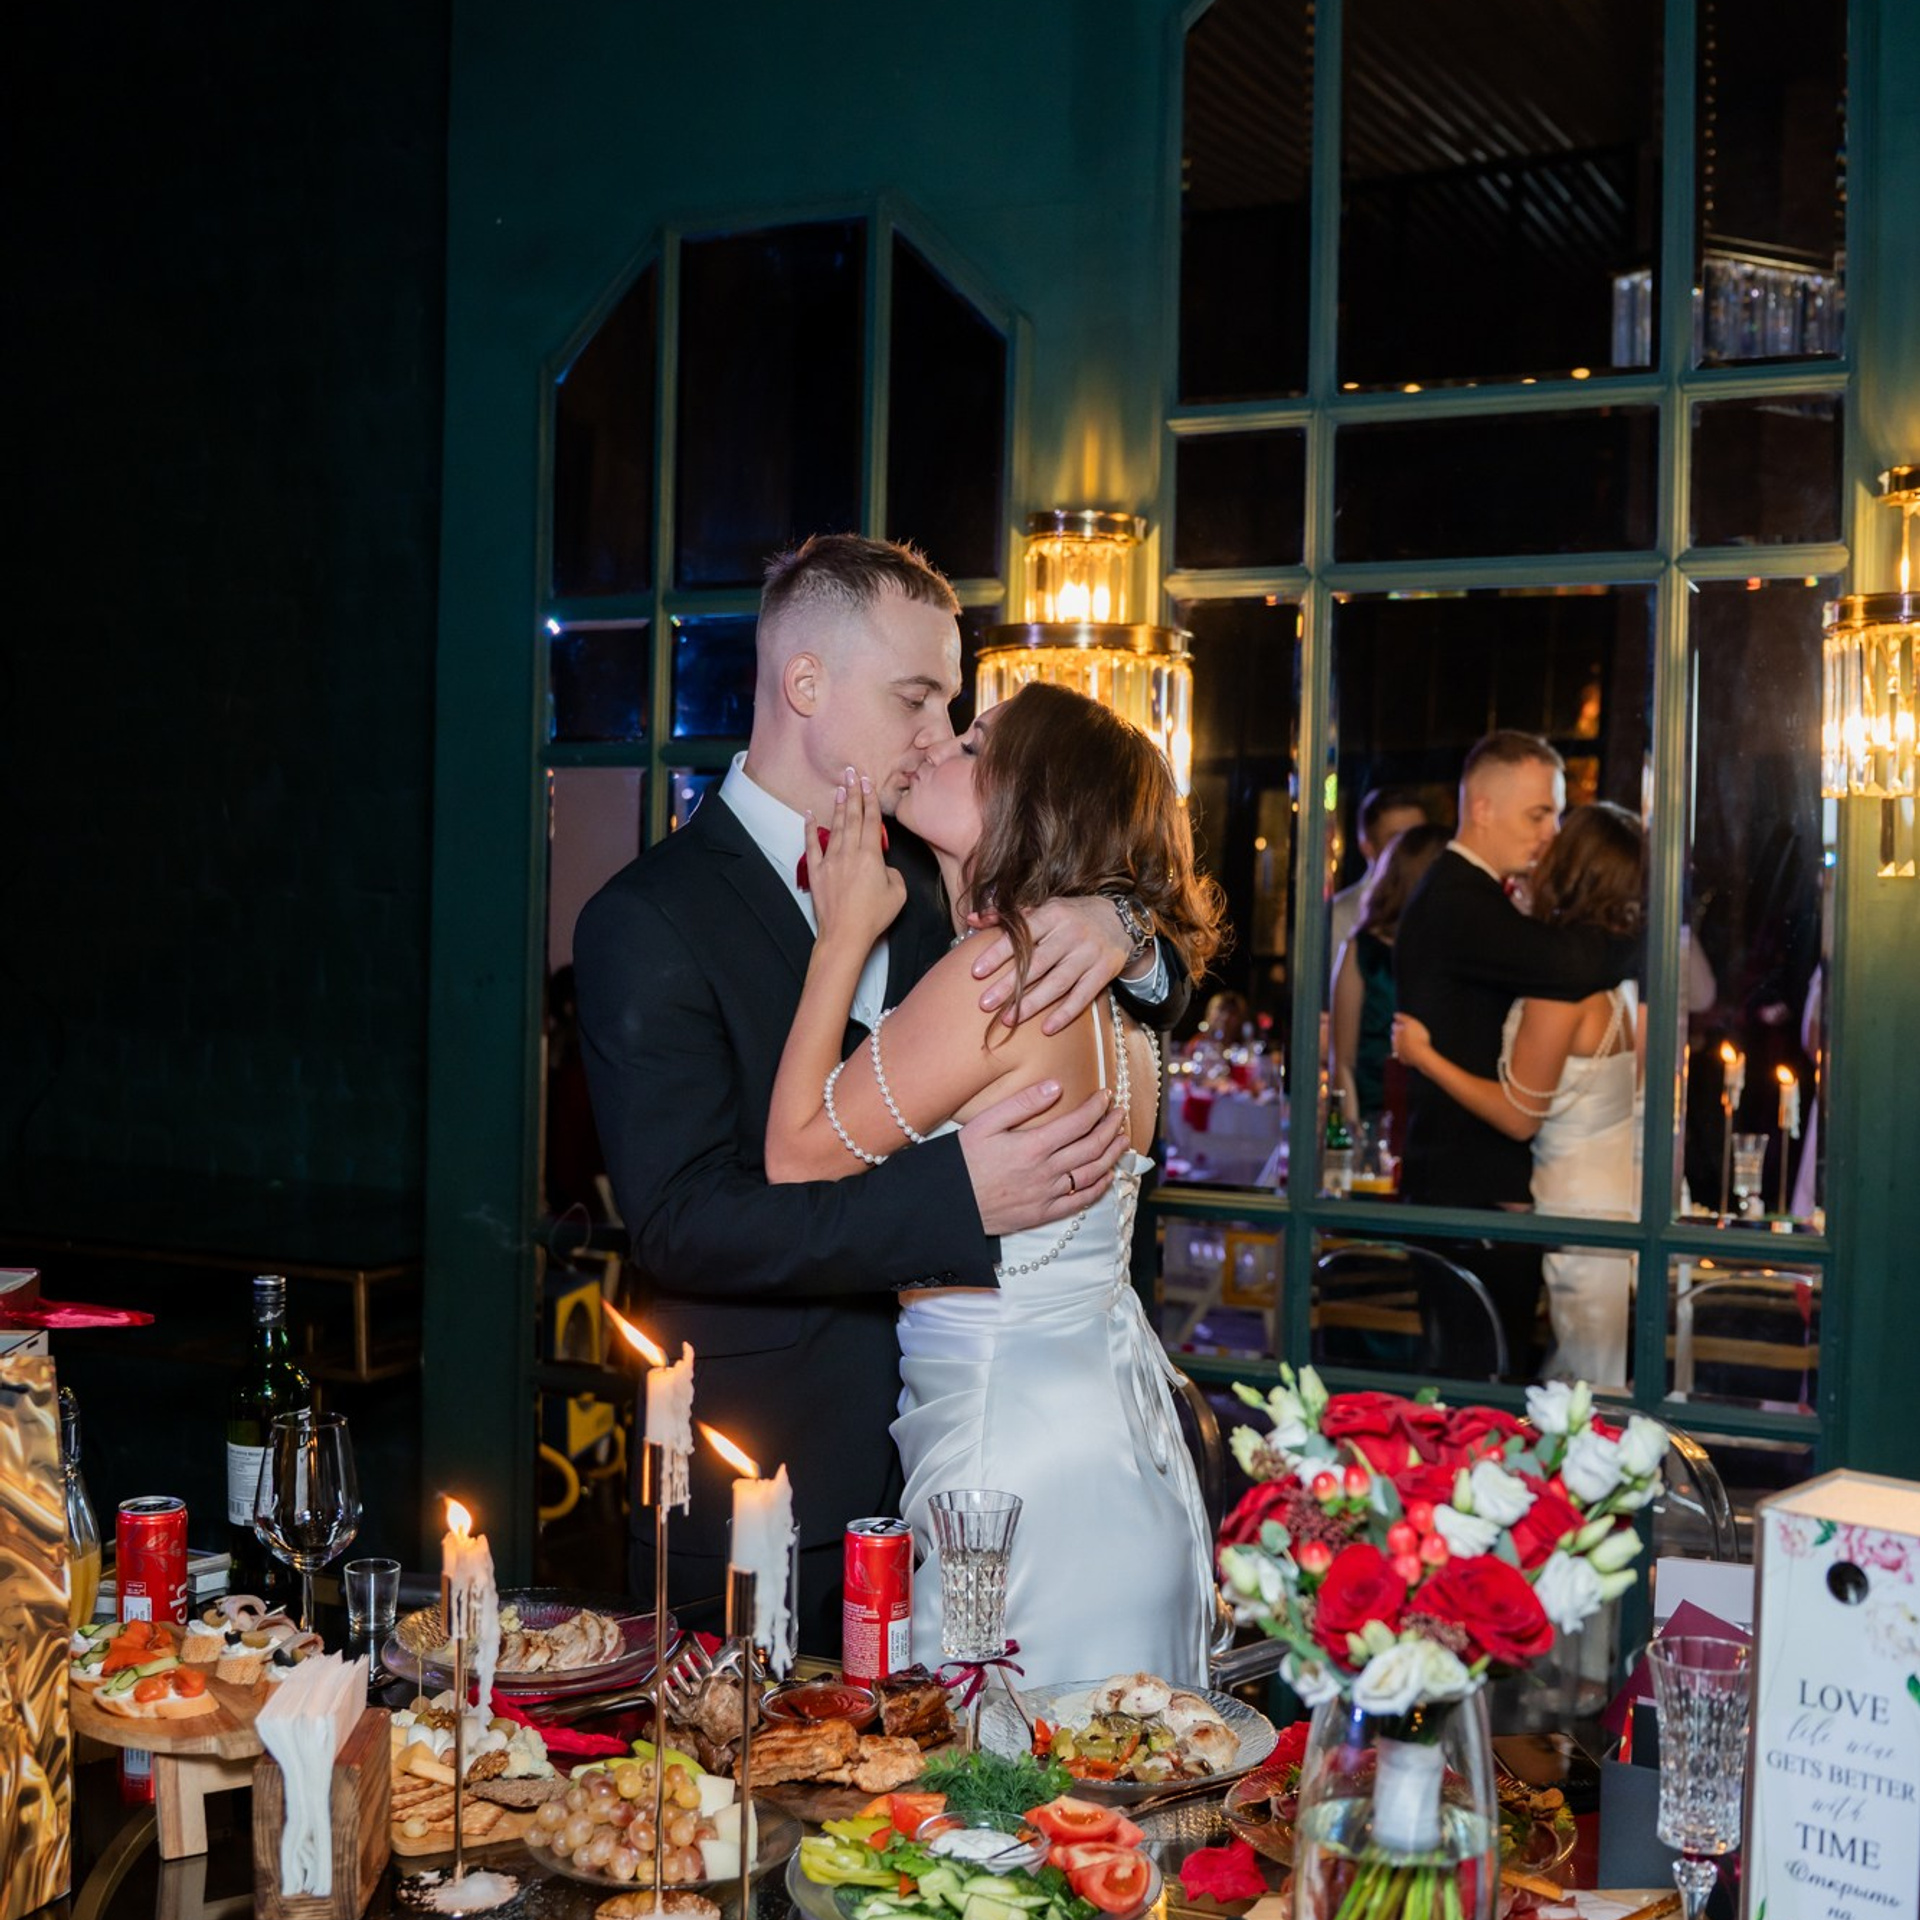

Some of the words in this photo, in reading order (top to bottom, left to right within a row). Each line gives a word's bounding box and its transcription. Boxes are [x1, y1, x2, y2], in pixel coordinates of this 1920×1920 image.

[1799, 1679, 1890, 1725] LOVE
[1766, 1750, 1822, 1779] GETS
[1829, 1764, 1916, 1803] BETTER
[1811, 1796, 1867, 1822] with
[1795, 1821, 1881, 1870] TIME
